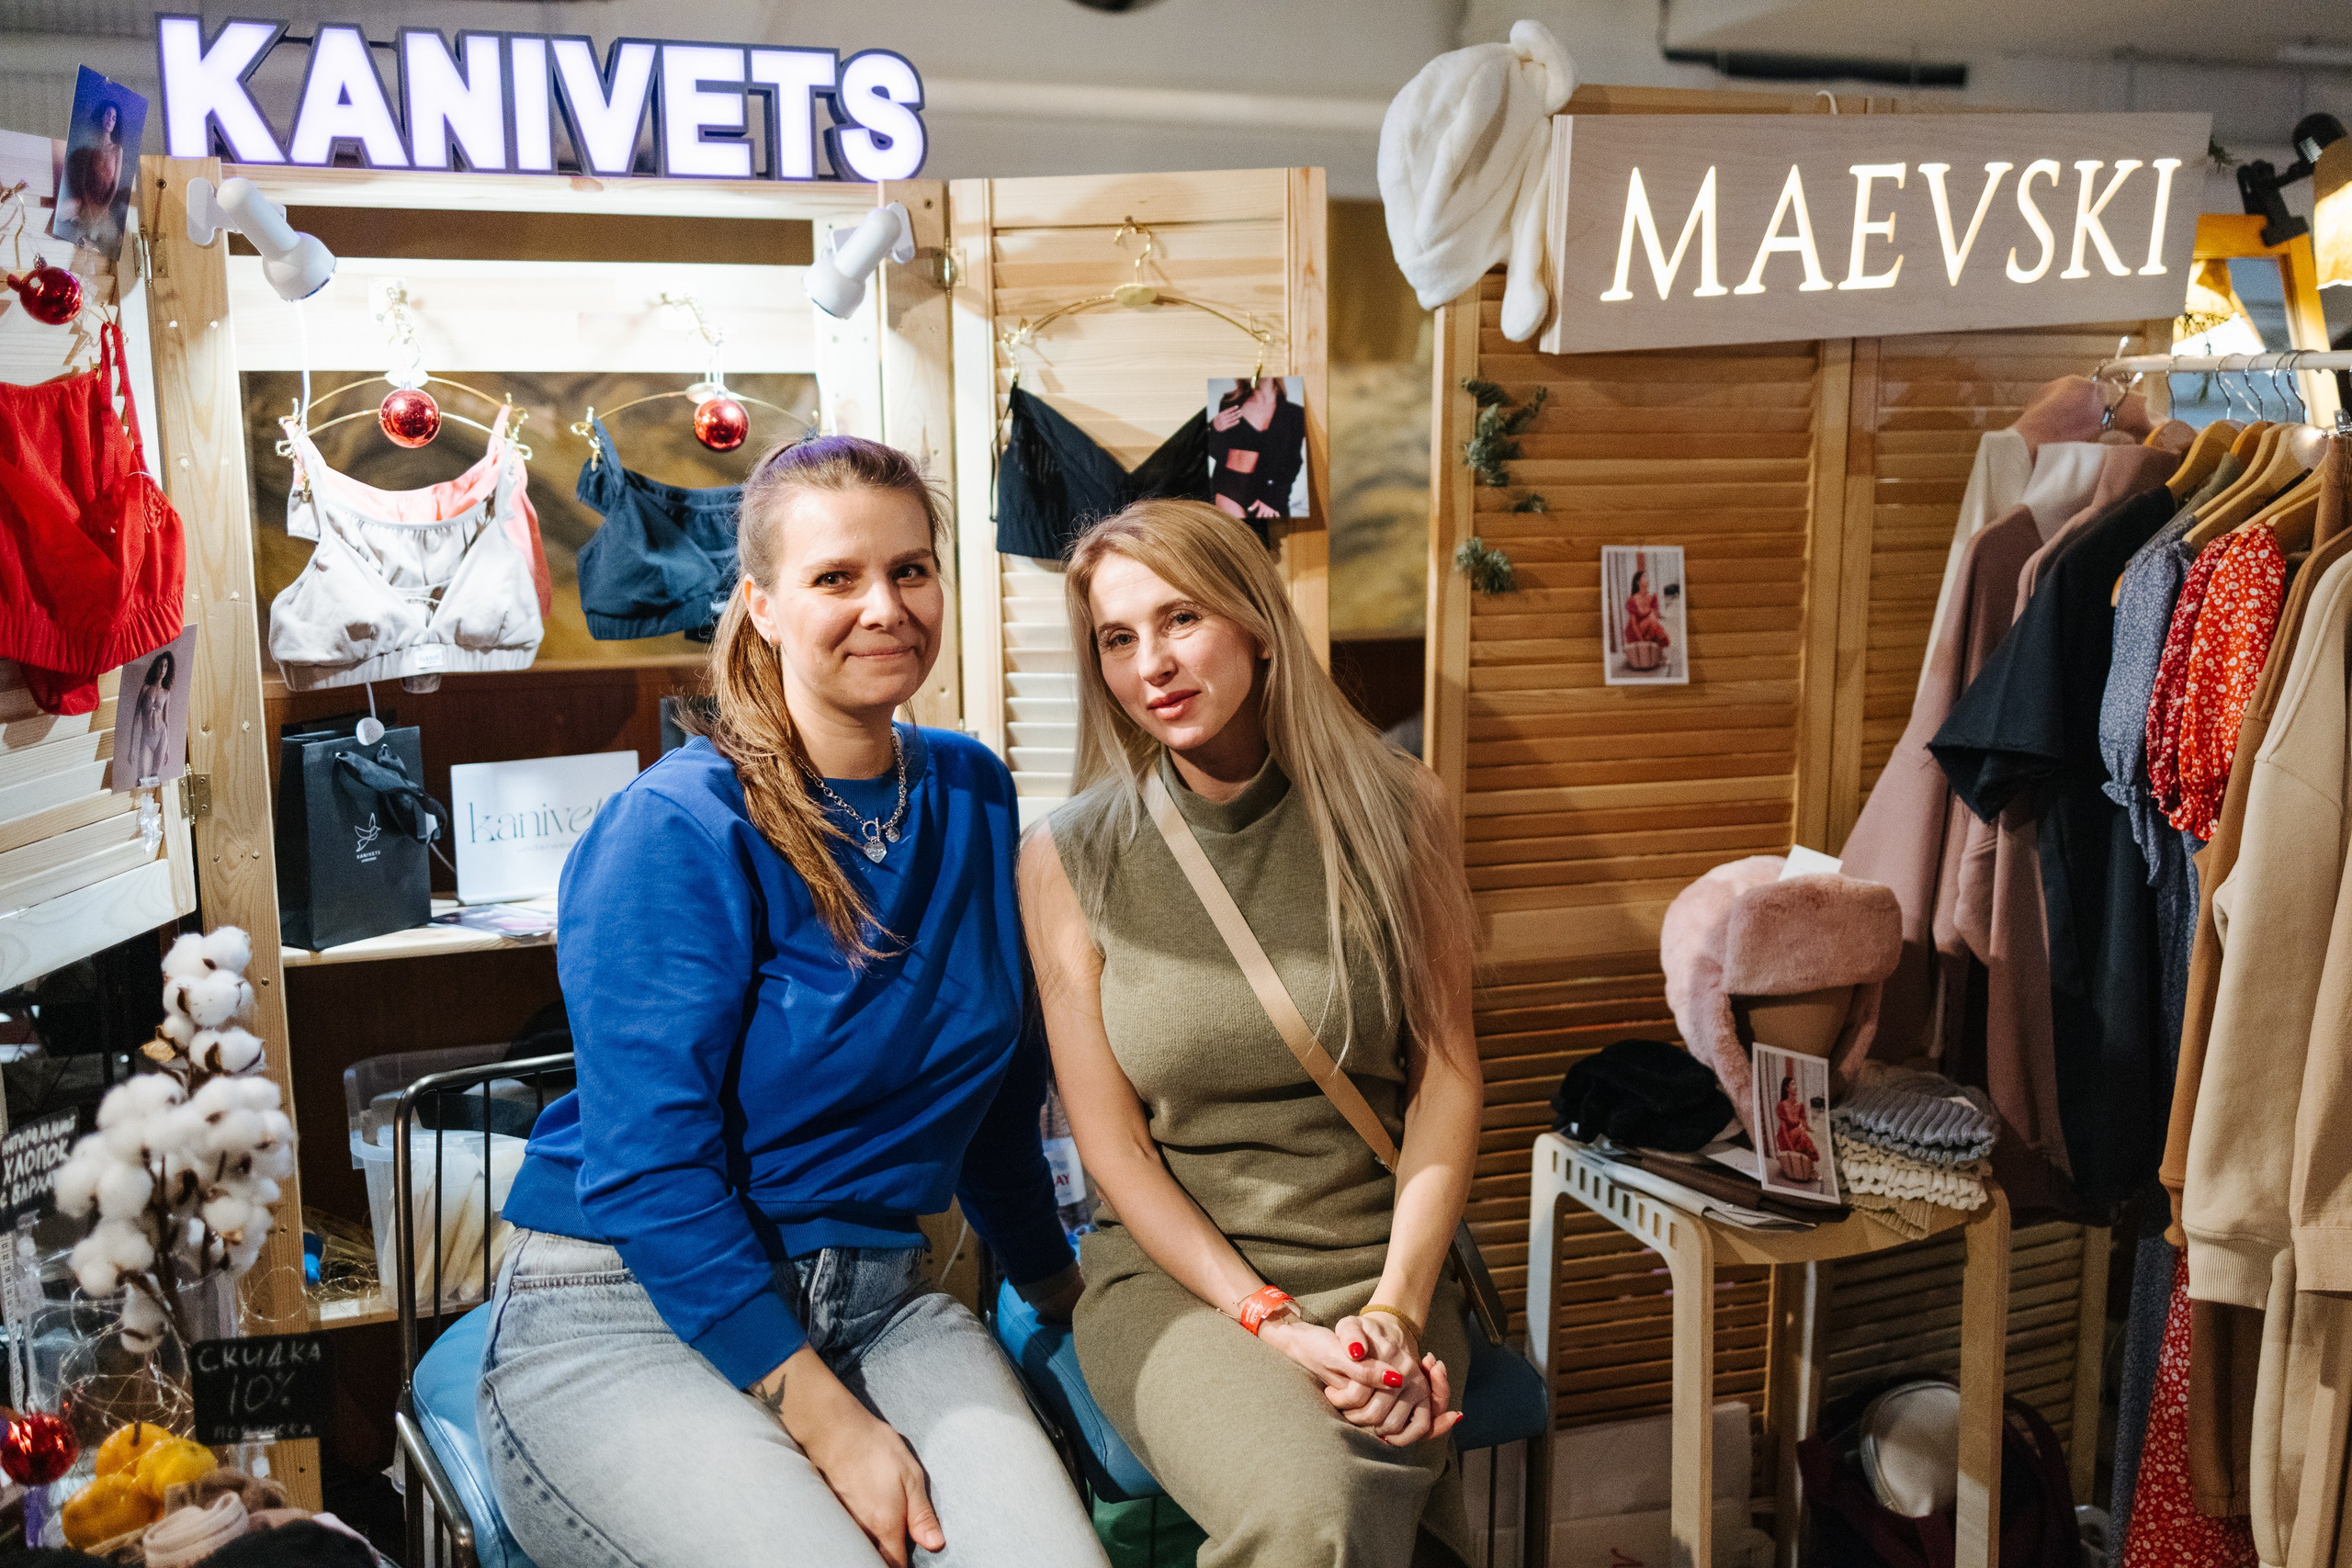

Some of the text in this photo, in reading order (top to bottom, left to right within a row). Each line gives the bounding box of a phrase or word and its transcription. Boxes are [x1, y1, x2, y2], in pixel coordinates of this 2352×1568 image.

[155, 13, 926, 182] KANIVETS
[1600, 159, 2181, 301] MAEVSKI
[516, 840, 573, 853] underwea
[3, 1138, 72, 1186] ХЛОПОК
[11, 1171, 55, 1206] БАРХА
[197, 1340, 322, 1372] СКИДКА
[230, 1371, 296, 1416] 10%
